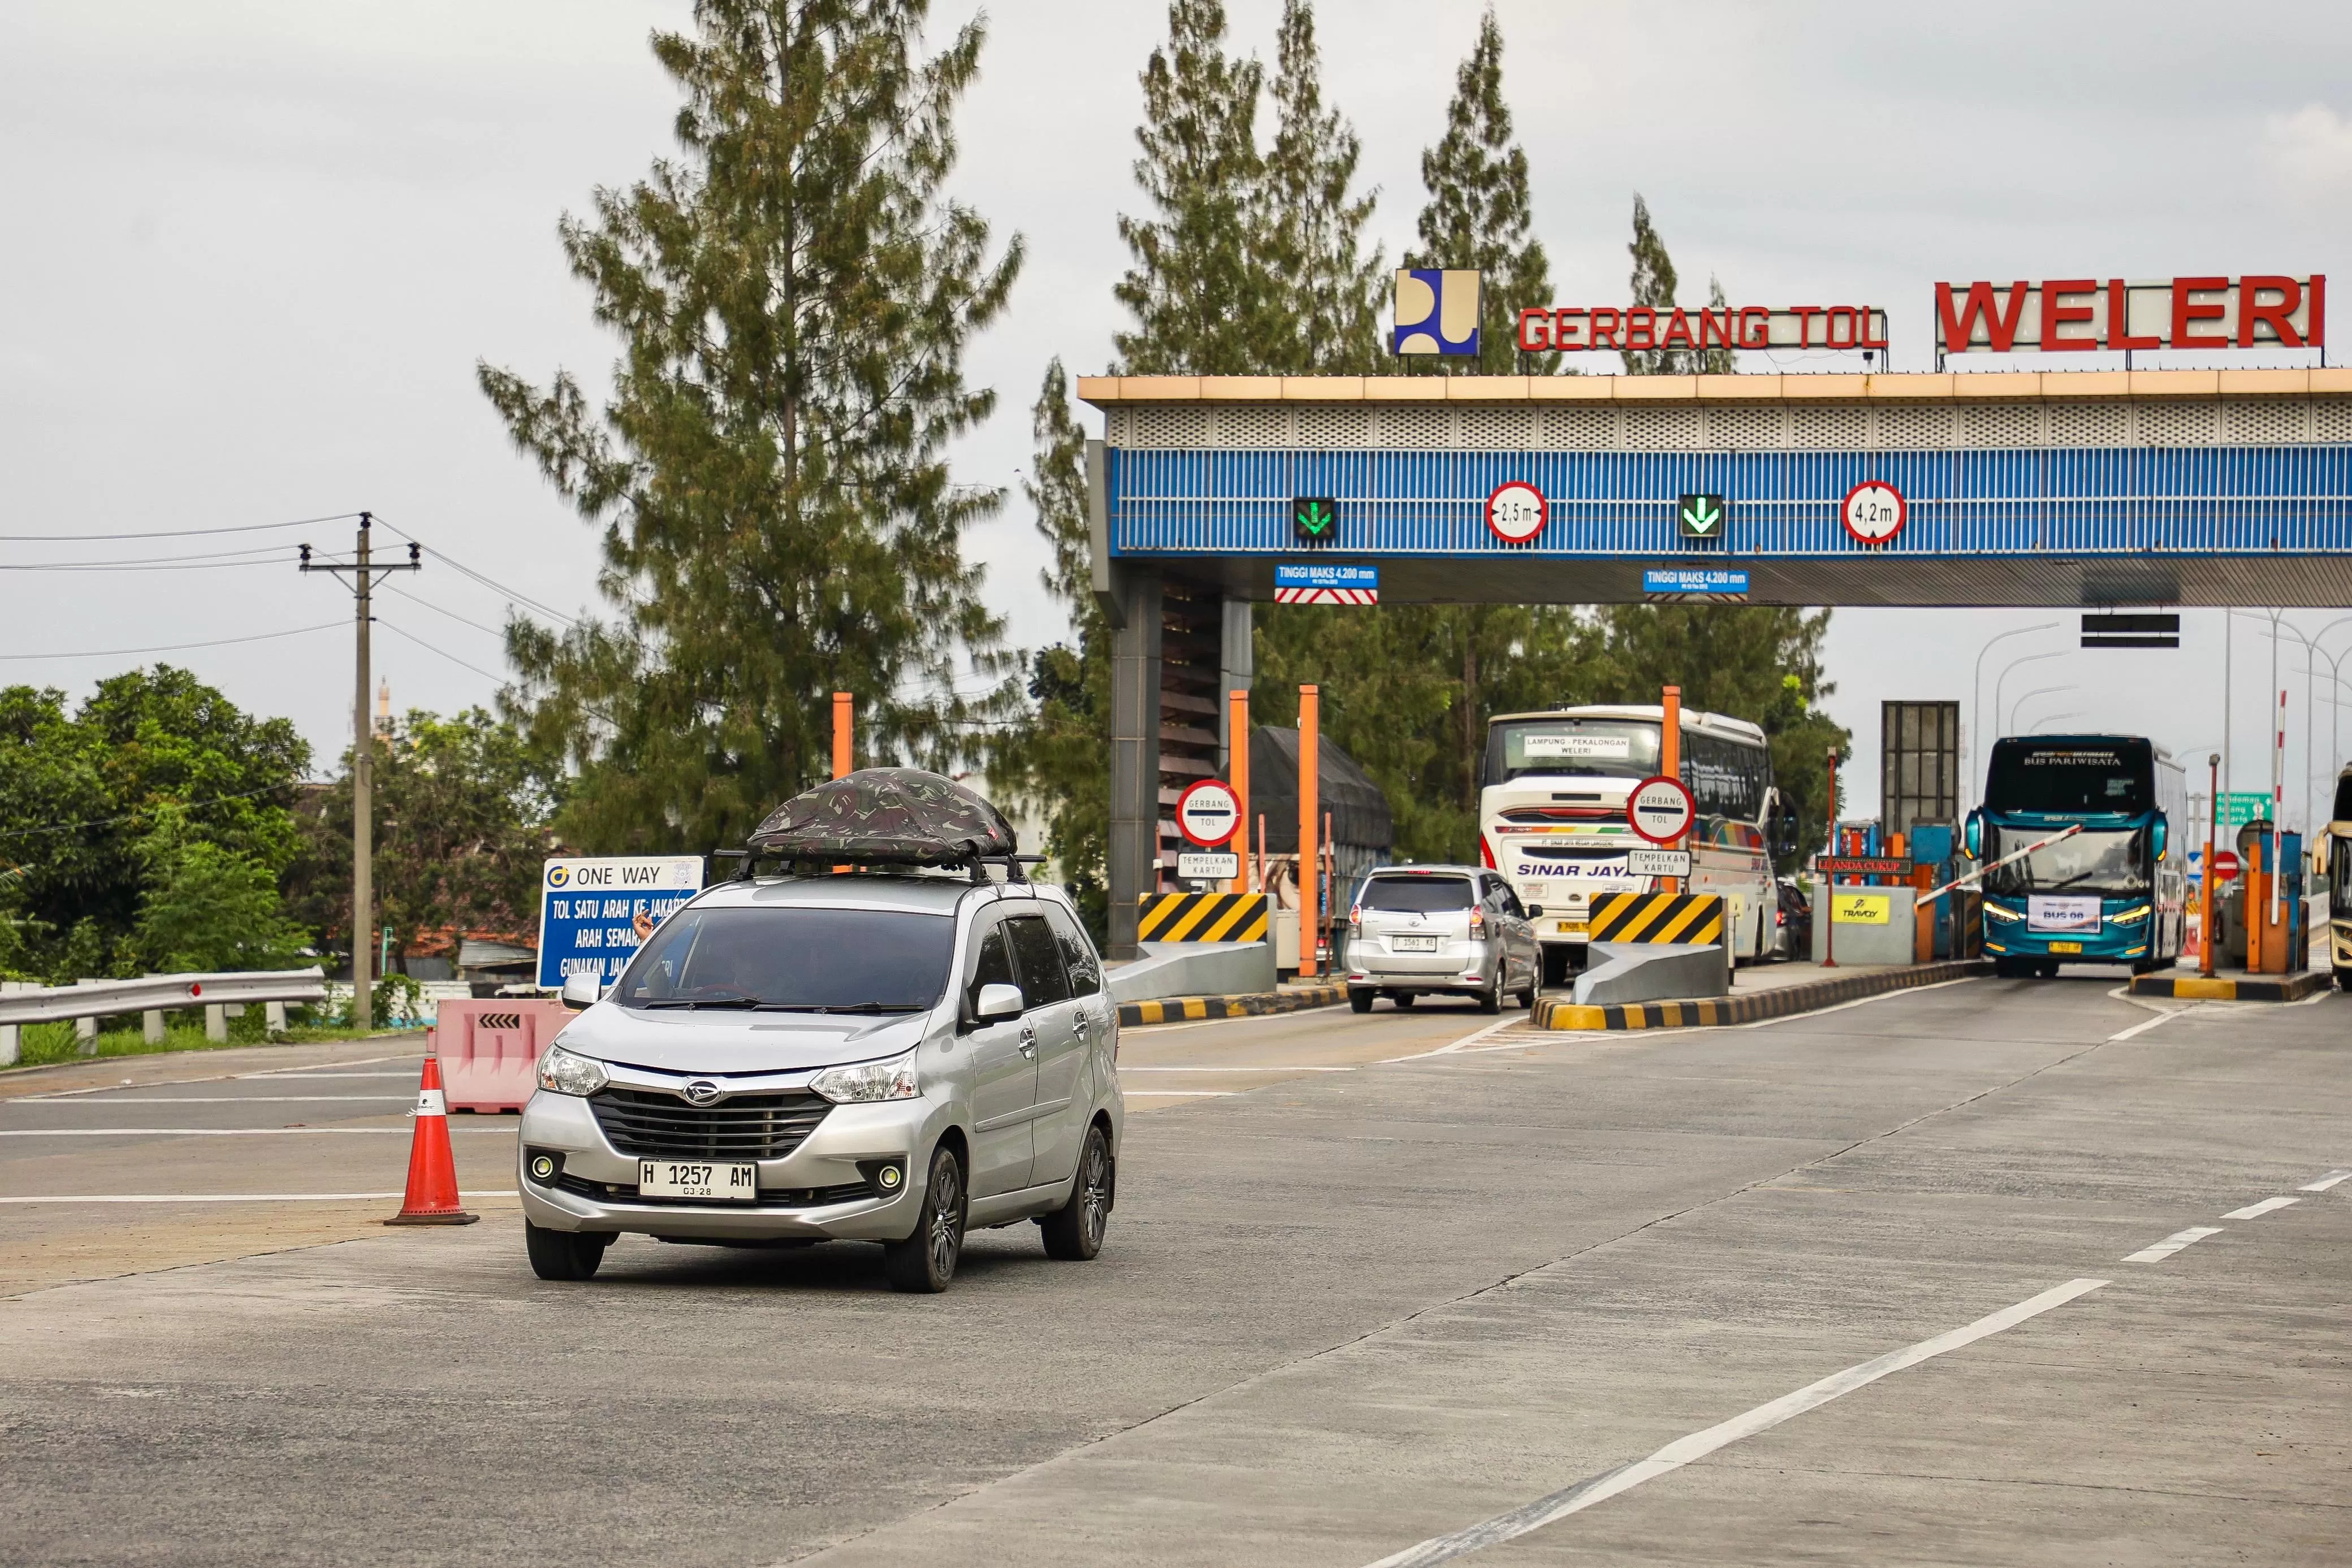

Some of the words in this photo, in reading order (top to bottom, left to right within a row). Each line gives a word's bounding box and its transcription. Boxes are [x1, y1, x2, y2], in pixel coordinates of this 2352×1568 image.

[1934, 275, 2325, 352] WELERI
[1519, 306, 1769, 351] GERBANG
[1789, 305, 1888, 349] TOL
[1502, 503, 1519, 525] 2,5
[1523, 507, 1532, 521] m
[1855, 503, 1877, 525] 4,2
[1880, 508, 1892, 522] m
[1279, 566, 1308, 578] TINGGI
[1309, 567, 1334, 579] MAKS
[1335, 568, 1357, 579] 4.200
[1358, 570, 1374, 579] mm
[1647, 571, 1677, 583] TINGGI
[1679, 571, 1704, 583] MAKS
[1705, 572, 1728, 583] 4.200
[1730, 574, 1745, 583] mm
[2048, 757, 2121, 766] PARIWISATA
[1189, 800, 1229, 808] GERBANG
[1640, 796, 1681, 806] GERBANG
[2217, 805, 2246, 815] Baang
[1201, 818, 1216, 826] TOL
[1183, 856, 1233, 865] TEMPELKAN
[1635, 853, 1685, 863] TEMPELKAN
[1517, 864, 1580, 876] SINAR
[1644, 864, 1674, 873] KARTU
[1833, 861, 1863, 870] ANDA
[1864, 862, 1900, 871] CUKUP
[577, 868, 612, 885] ONE
[623, 867, 660, 884] WAY
[553, 900, 570, 919] TOL
[574, 900, 599, 919] SATU
[602, 899, 628, 919] ARAH
[648, 898, 688, 917] JAKAR
[2043, 911, 2066, 920] BUS
[575, 929, 602, 948] ARAH
[606, 928, 641, 947] SEMAR
[560, 958, 606, 977] GUNAKAN
[644, 1164, 654, 1183] H
[669, 1165, 712, 1185] 1257
[730, 1167, 751, 1186] AM
